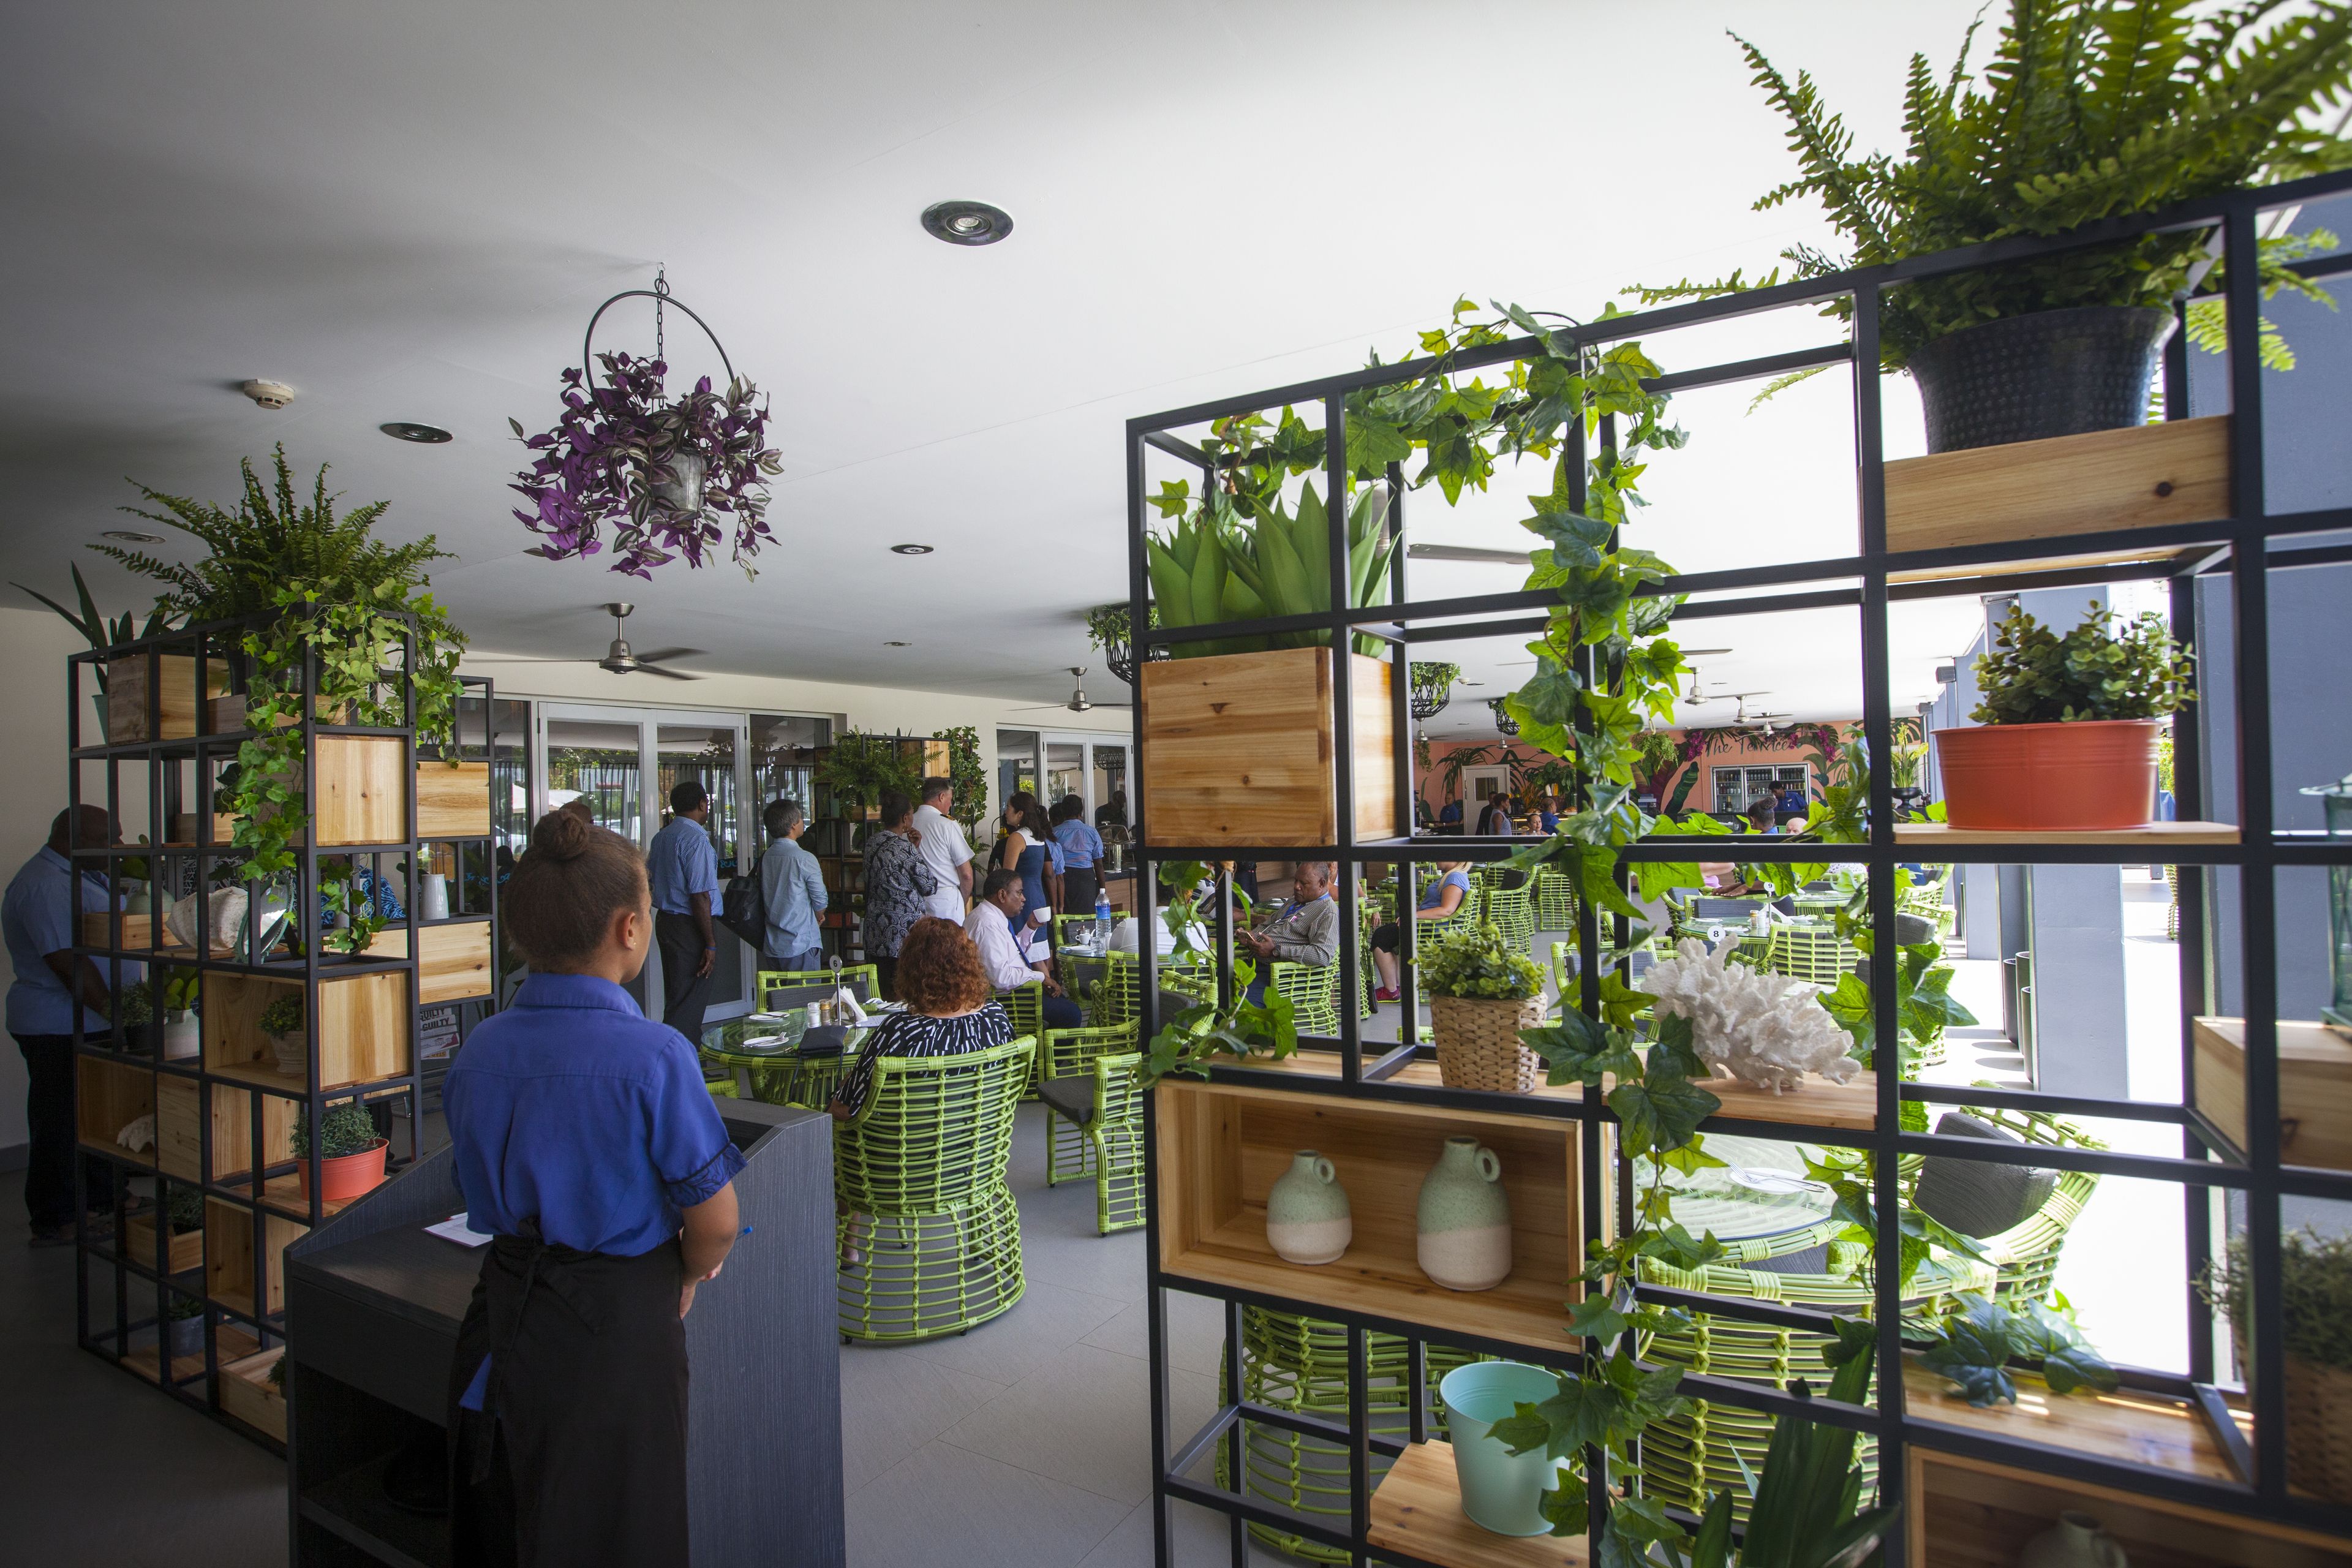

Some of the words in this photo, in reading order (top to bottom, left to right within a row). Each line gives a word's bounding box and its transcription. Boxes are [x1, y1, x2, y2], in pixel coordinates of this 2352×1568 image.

[1705, 736, 1733, 757] The
[421, 1008, 445, 1022] GUILTY
[423, 1017, 450, 1031] GUILTY
